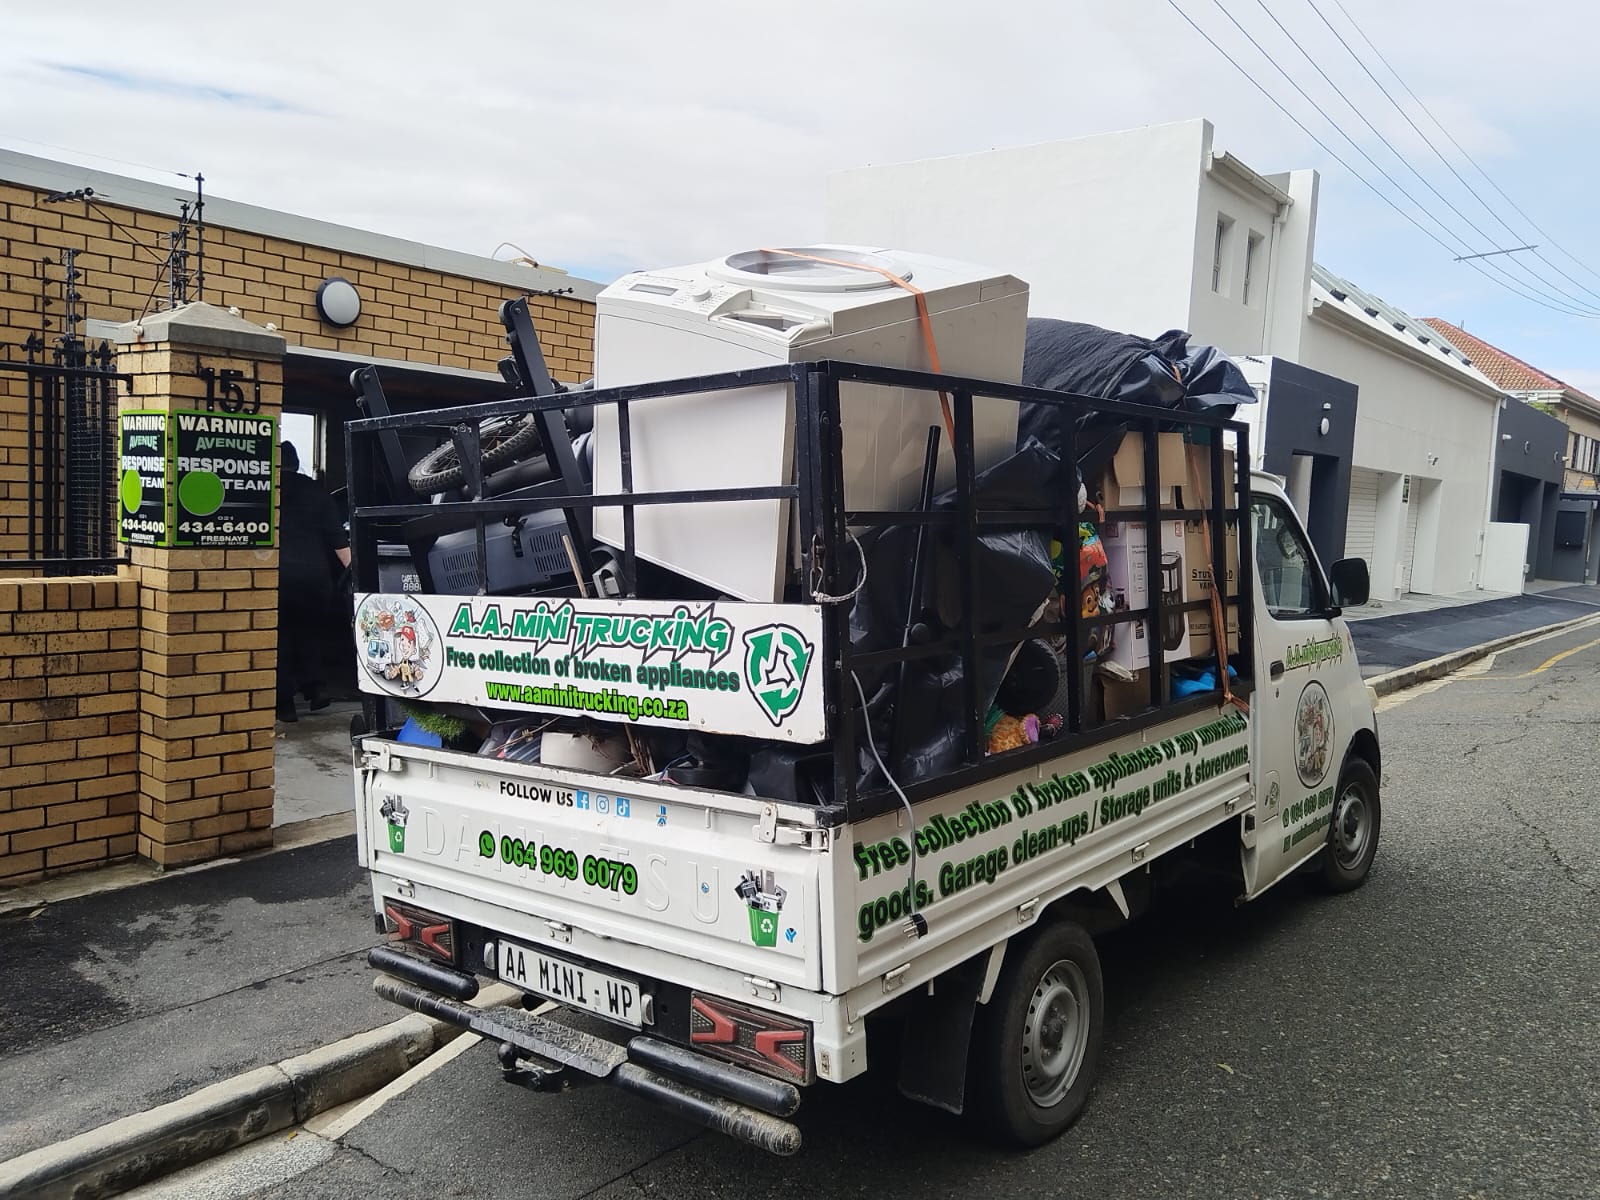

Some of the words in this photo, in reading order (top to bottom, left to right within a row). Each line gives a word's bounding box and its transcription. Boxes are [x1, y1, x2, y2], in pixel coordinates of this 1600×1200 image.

[202, 367, 260, 414] 15J
[122, 415, 165, 431] WARNING
[178, 415, 272, 436] WARNING
[129, 434, 158, 450] AVENUE
[195, 436, 256, 454] AVENUE
[122, 456, 165, 471] RESPONSE
[178, 457, 271, 475] RESPONSE
[141, 476, 165, 488] TEAM
[222, 479, 271, 491] TEAM
[122, 518, 165, 533] 434-6400
[178, 522, 270, 533] 434-6400
[446, 646, 475, 669] Free
[479, 649, 551, 676] collection
[554, 655, 570, 678] of
[573, 655, 632, 683] broken
[636, 661, 740, 692] appliances
[486, 681, 689, 721] www.aaminitrucking.co.za
[500, 780, 552, 804] FOLLOW
[556, 790, 574, 808] US
[853, 837, 911, 881] Free
[911, 800, 1013, 858] collection
[1010, 784, 1033, 819] of
[1026, 773, 1091, 812] broken
[1087, 751, 1163, 793] appliances
[1160, 738, 1177, 760] or
[1174, 730, 1199, 756] any
[1197, 710, 1248, 746] unwanted
[938, 845, 1009, 885] Garage
[1012, 811, 1089, 865] clean-ups
[1099, 785, 1150, 826] Storage
[1152, 770, 1182, 799] units
[1184, 762, 1194, 789] &
[501, 836, 536, 870] 064
[540, 844, 578, 880] 969
[583, 855, 638, 895] 6079
[506, 947, 527, 983] AA
[539, 958, 586, 1004] MINI
[607, 980, 633, 1017] WP
